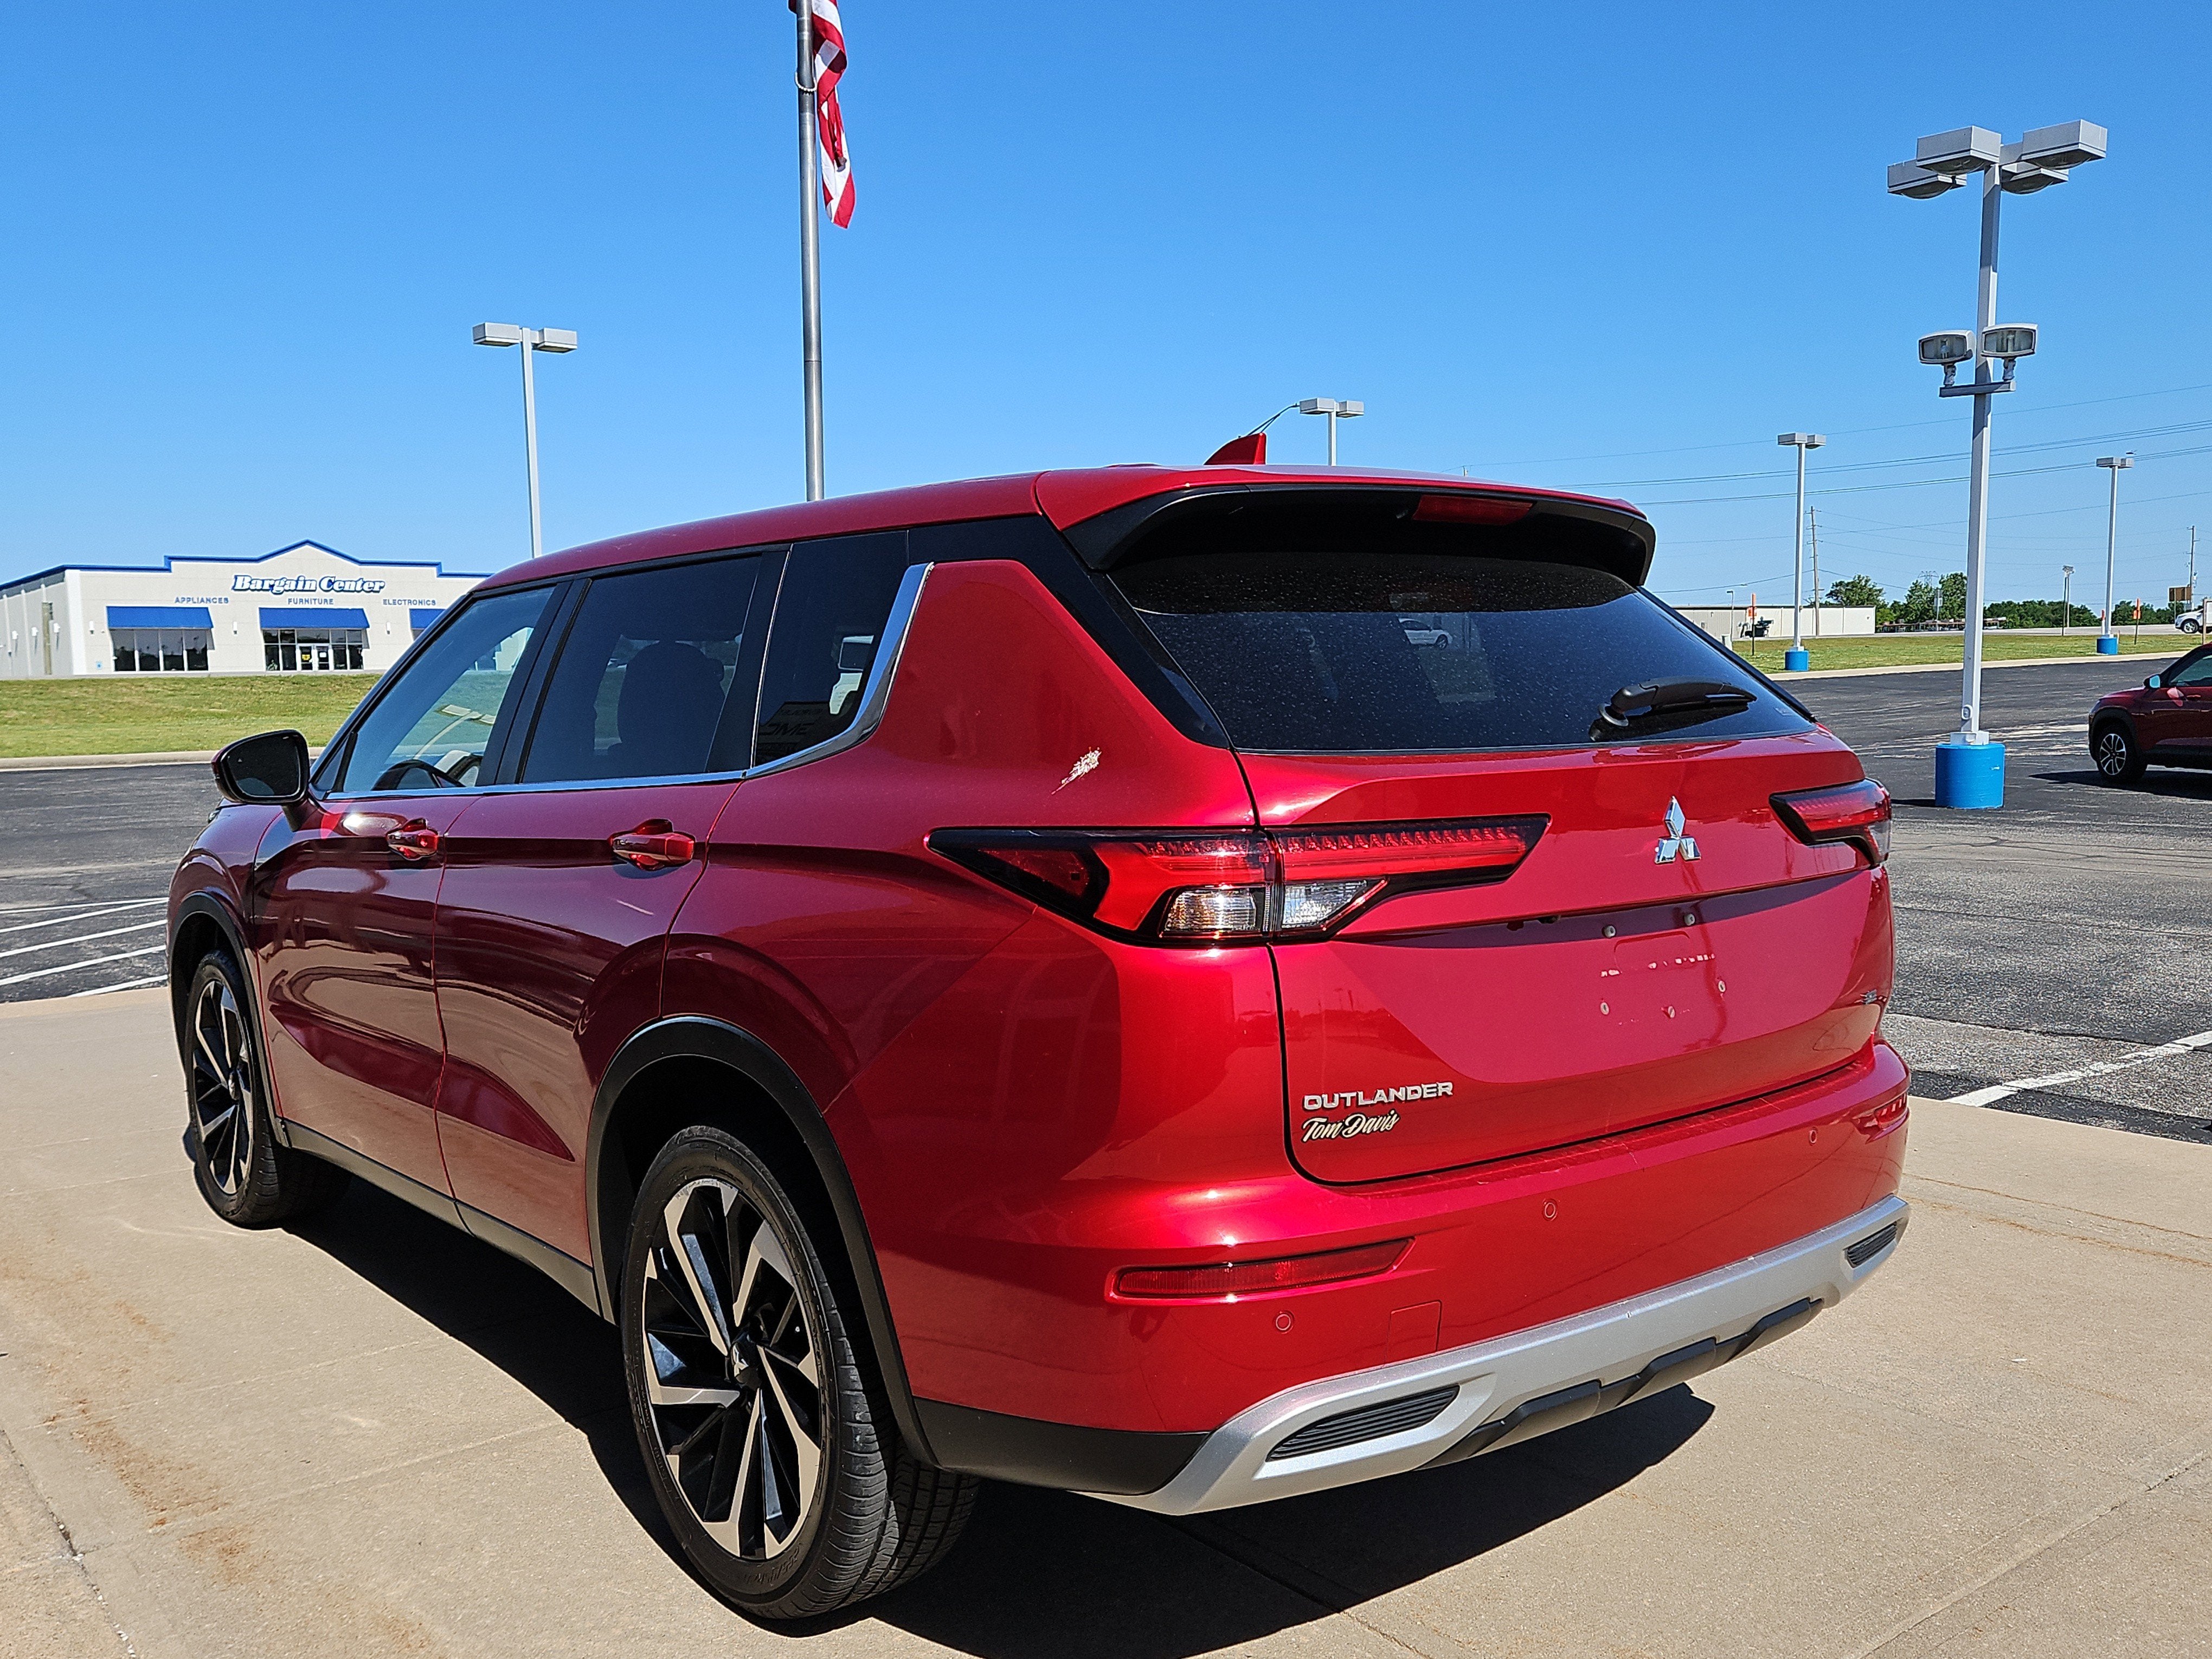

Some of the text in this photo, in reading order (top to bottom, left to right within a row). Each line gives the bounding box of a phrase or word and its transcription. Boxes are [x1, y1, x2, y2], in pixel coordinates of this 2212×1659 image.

[232, 575, 385, 595] Bargain Center
[1304, 1082, 1454, 1110] OUTLANDER
[1302, 1110, 1400, 1142] Tom Davis
